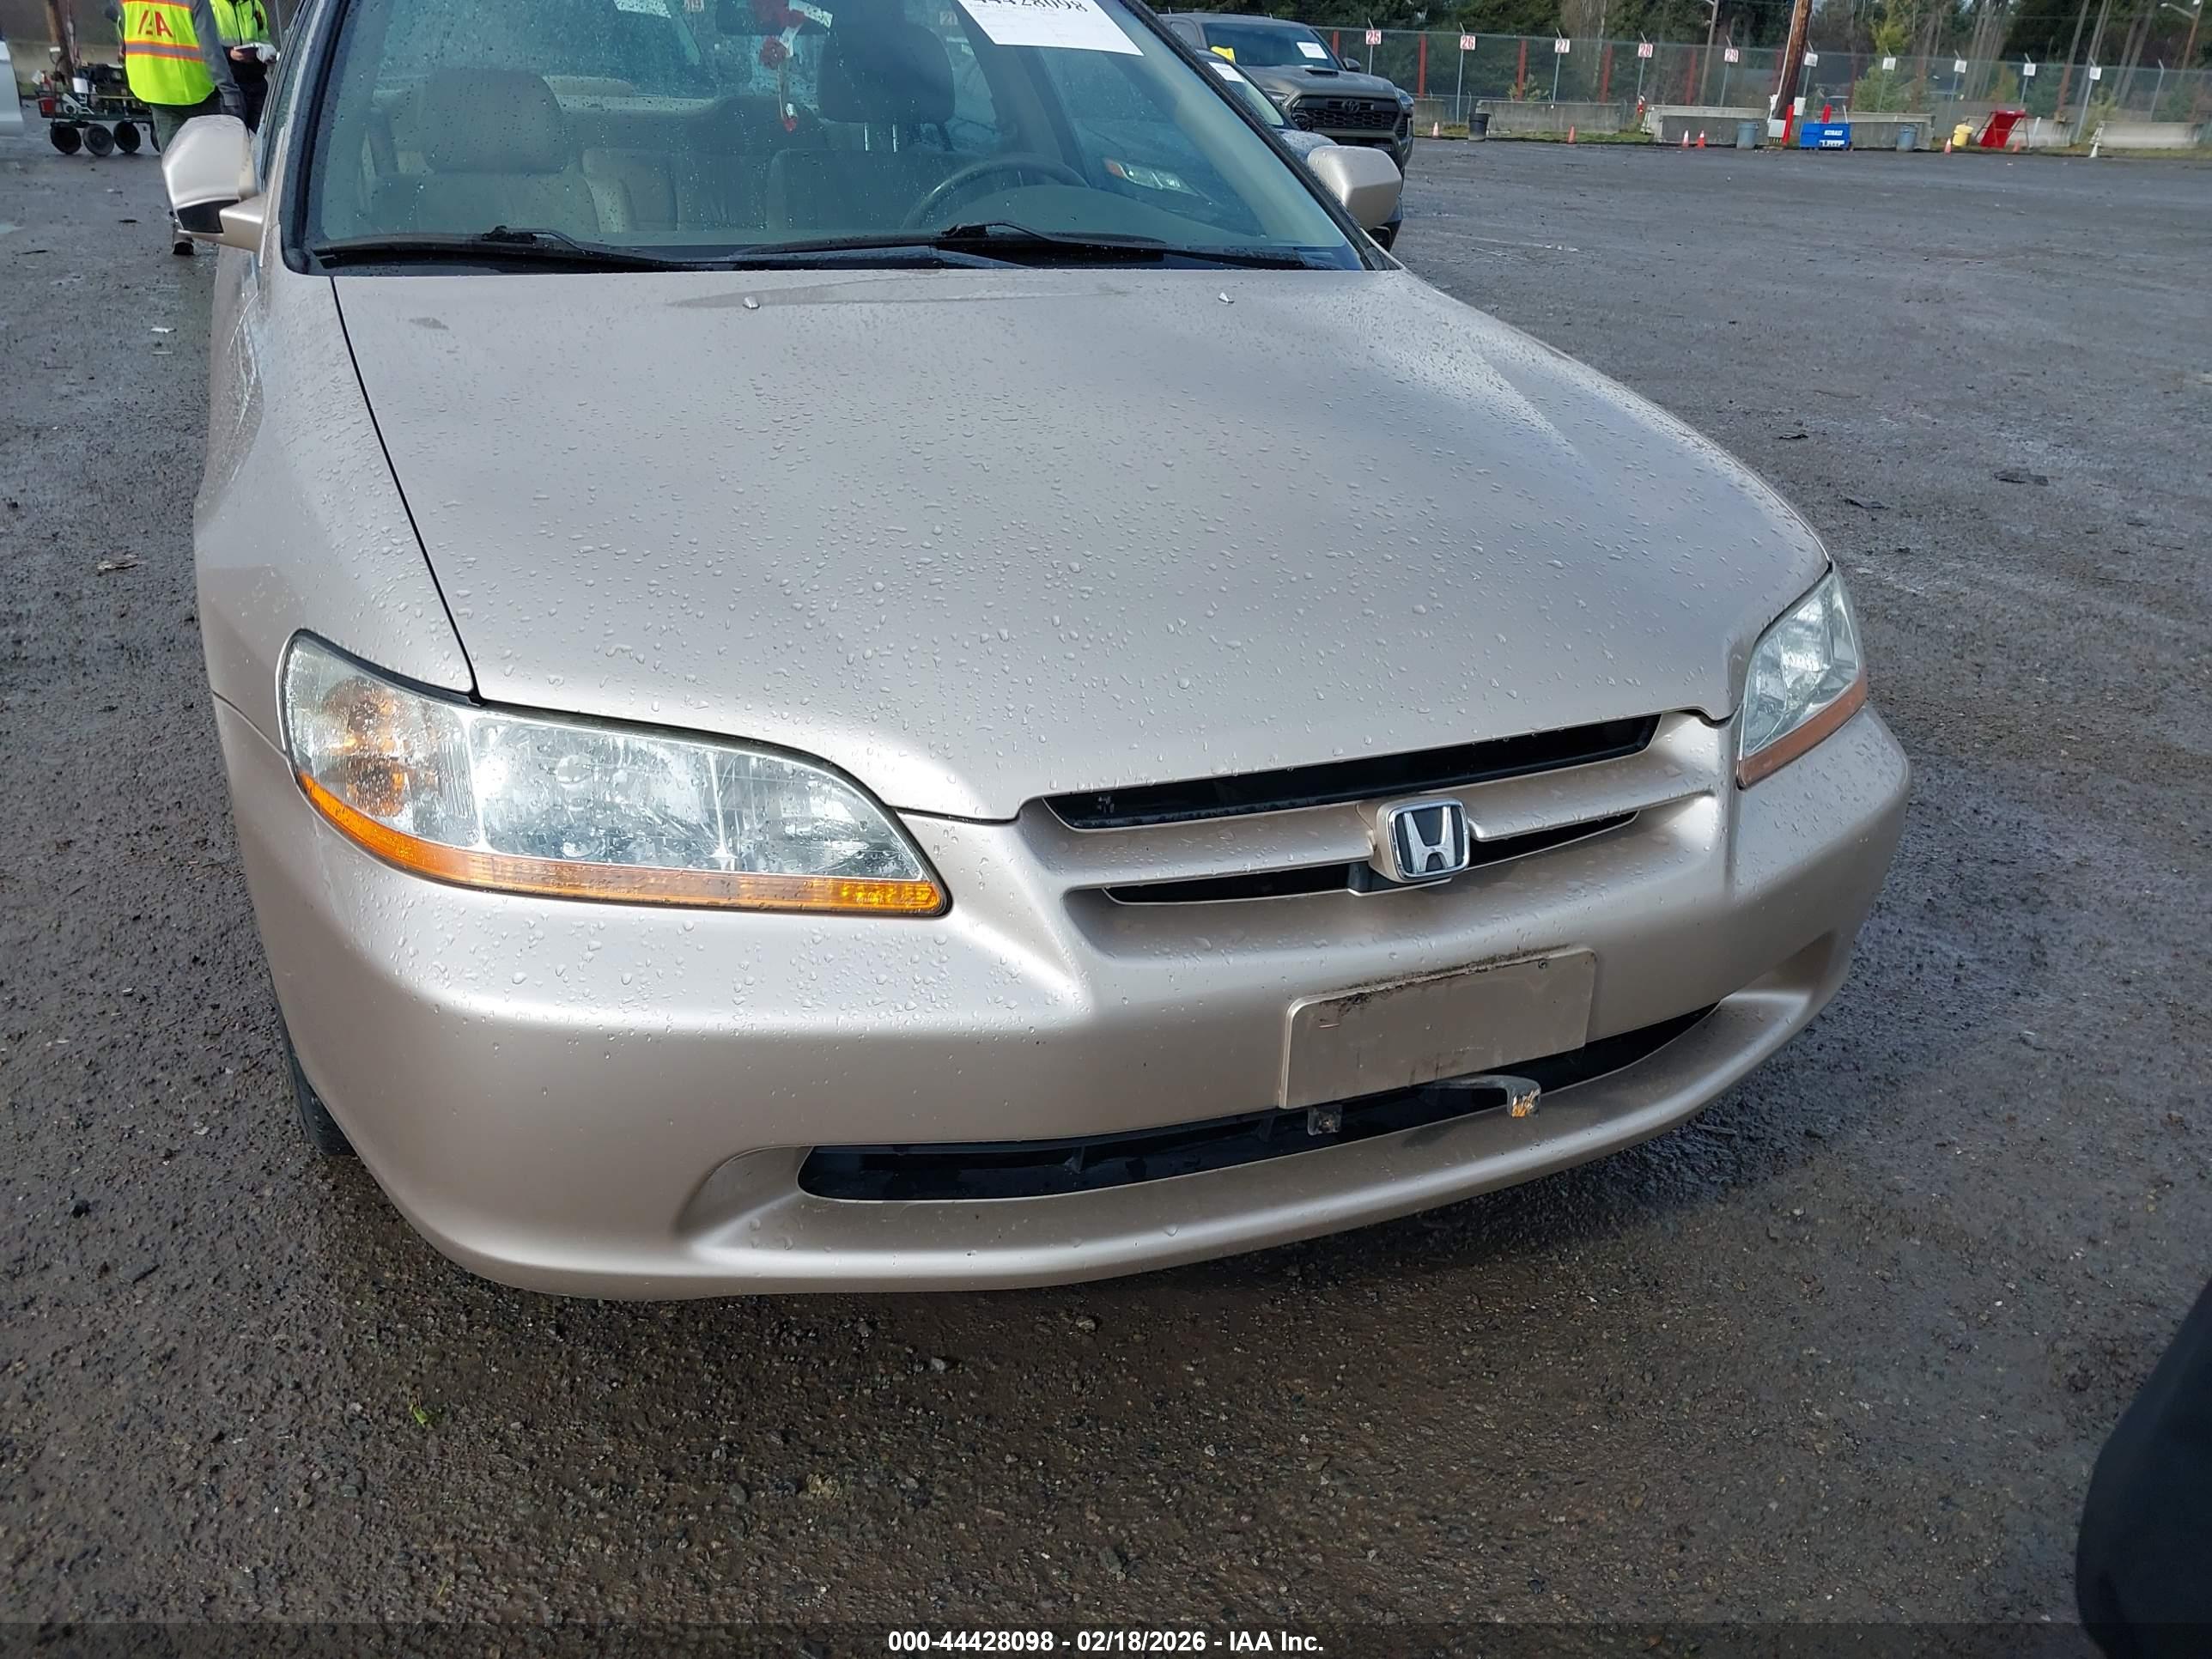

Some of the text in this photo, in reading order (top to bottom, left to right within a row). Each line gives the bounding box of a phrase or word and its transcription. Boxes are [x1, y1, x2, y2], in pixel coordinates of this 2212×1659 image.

[1367, 31, 1381, 44] 25
[1462, 36, 1475, 49] 26
[1556, 40, 1569, 52] 27
[1638, 44, 1652, 57] 28
